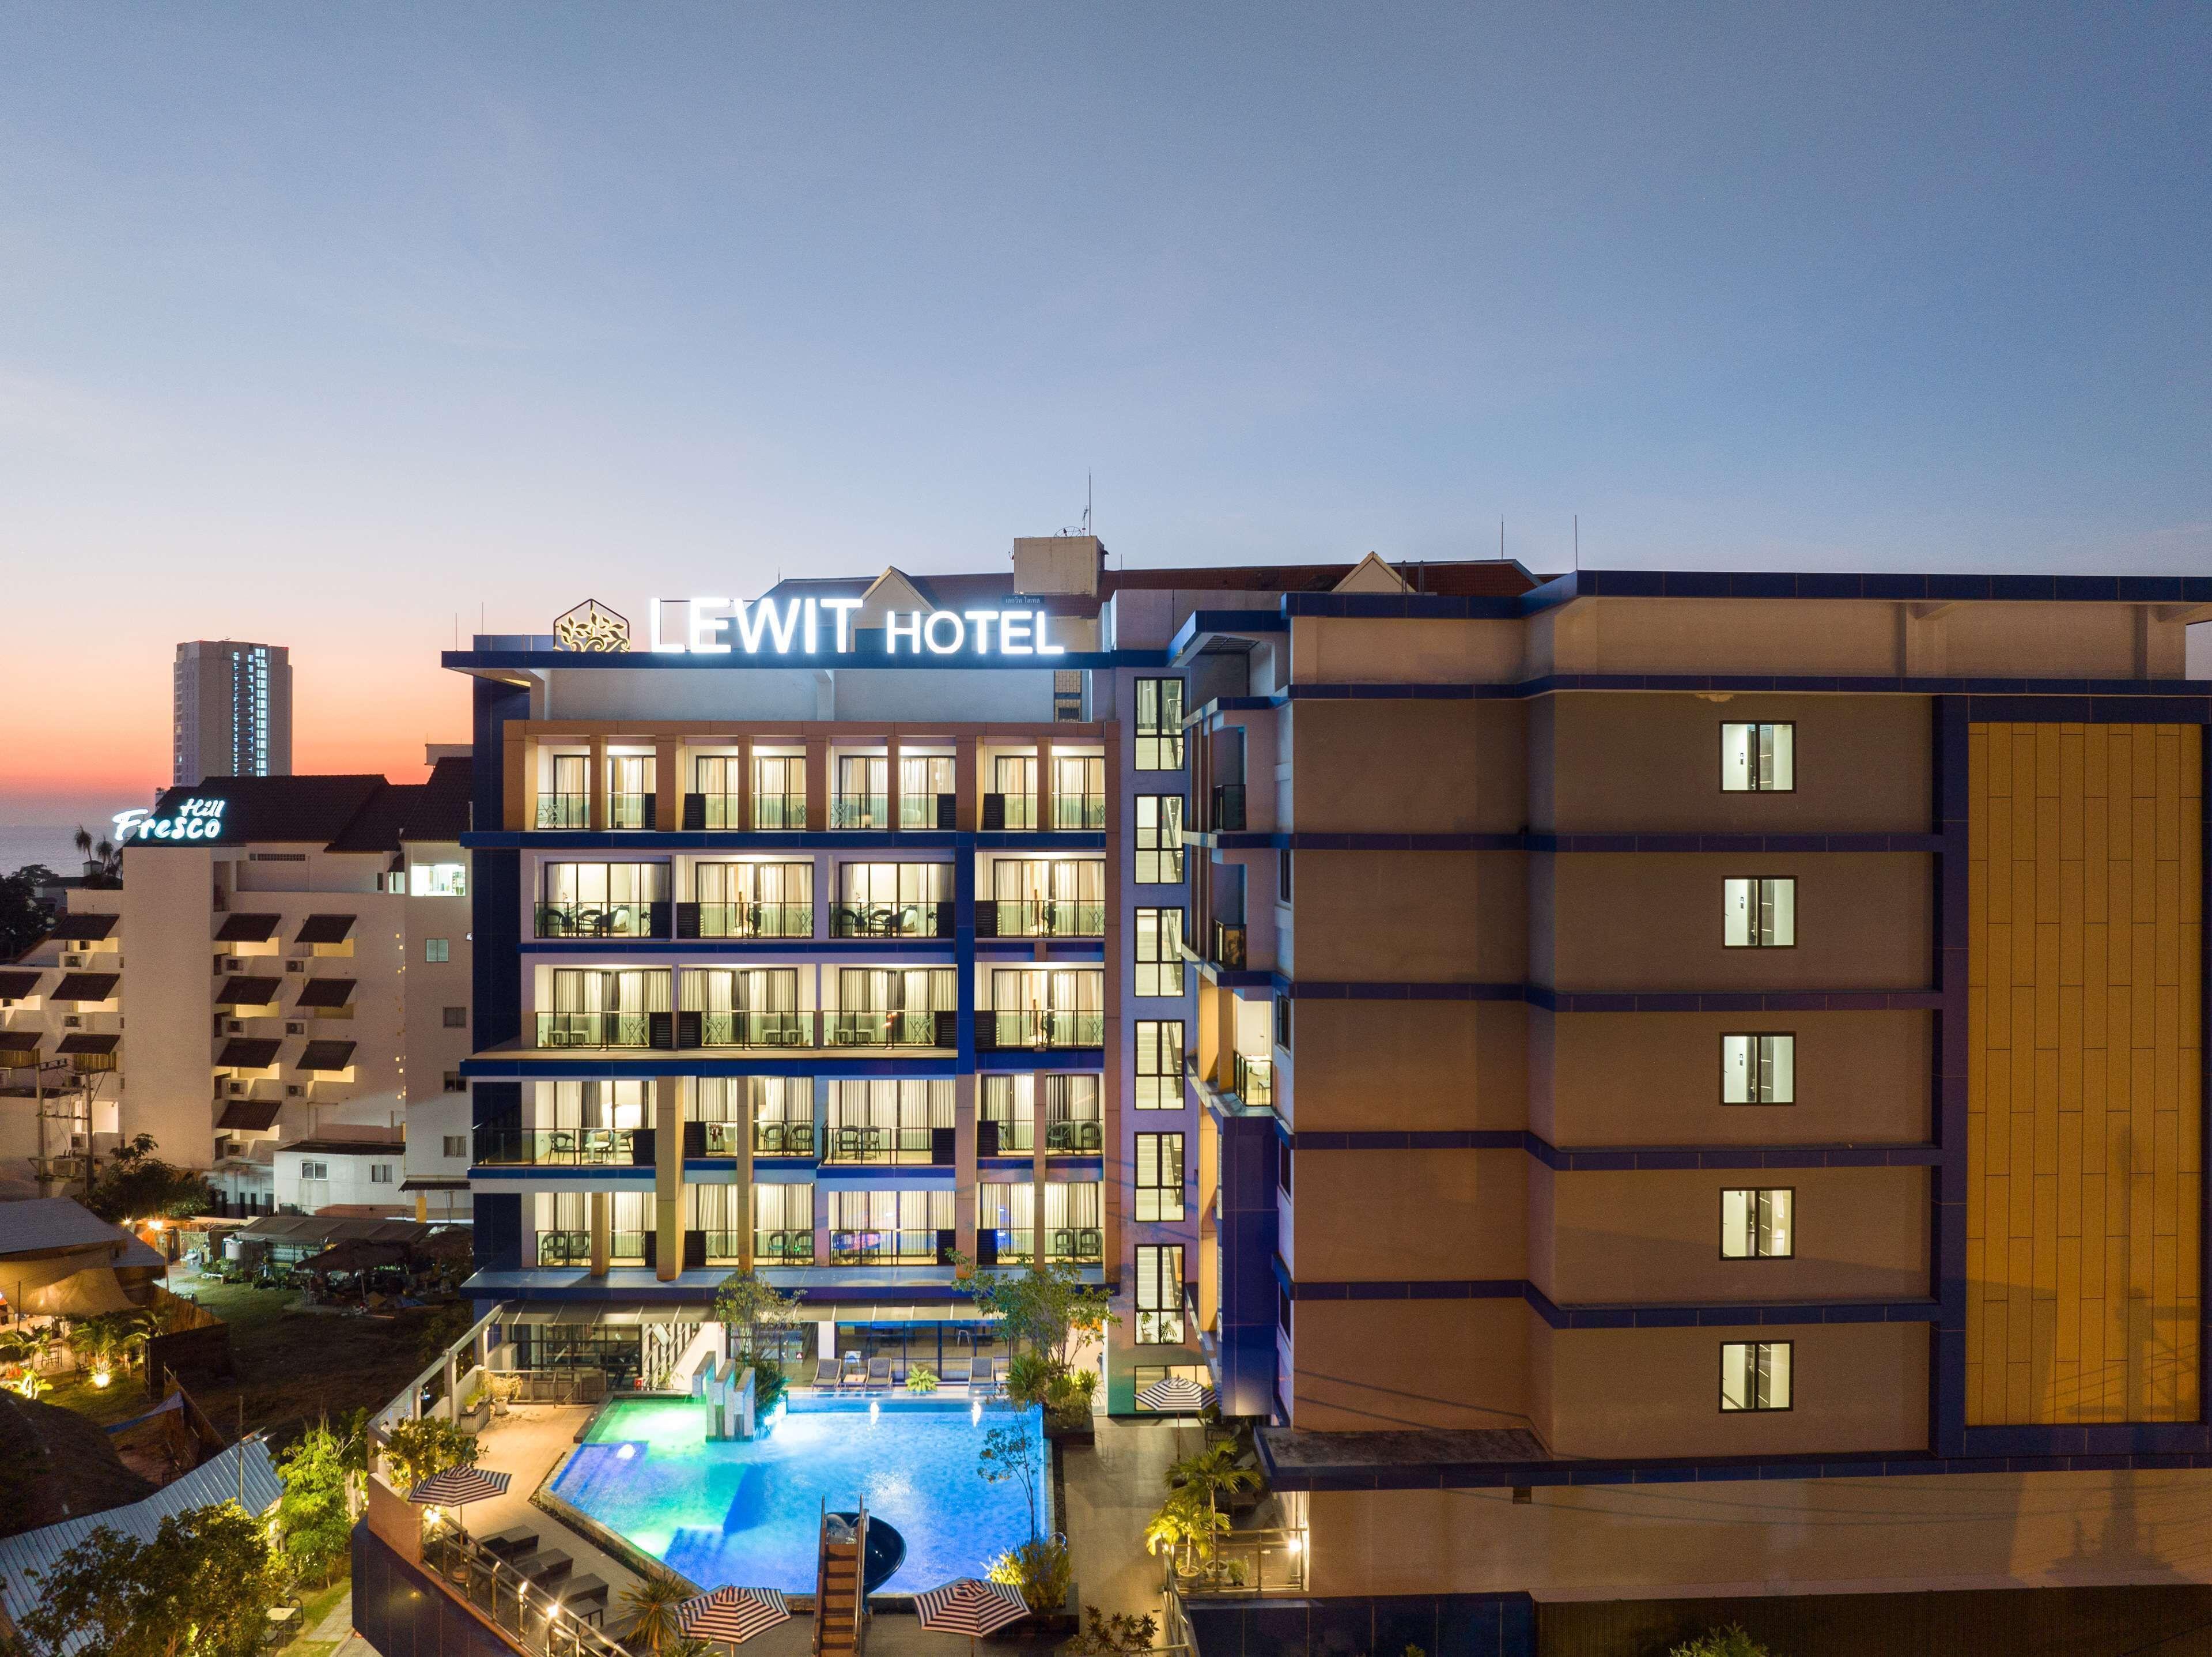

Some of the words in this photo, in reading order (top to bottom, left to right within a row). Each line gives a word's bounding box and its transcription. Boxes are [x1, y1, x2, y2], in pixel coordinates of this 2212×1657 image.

[651, 598, 864, 654] LEWIT
[887, 611, 1065, 654] HOTEL
[180, 798, 226, 818] Hill
[112, 809, 221, 841] Fresco
